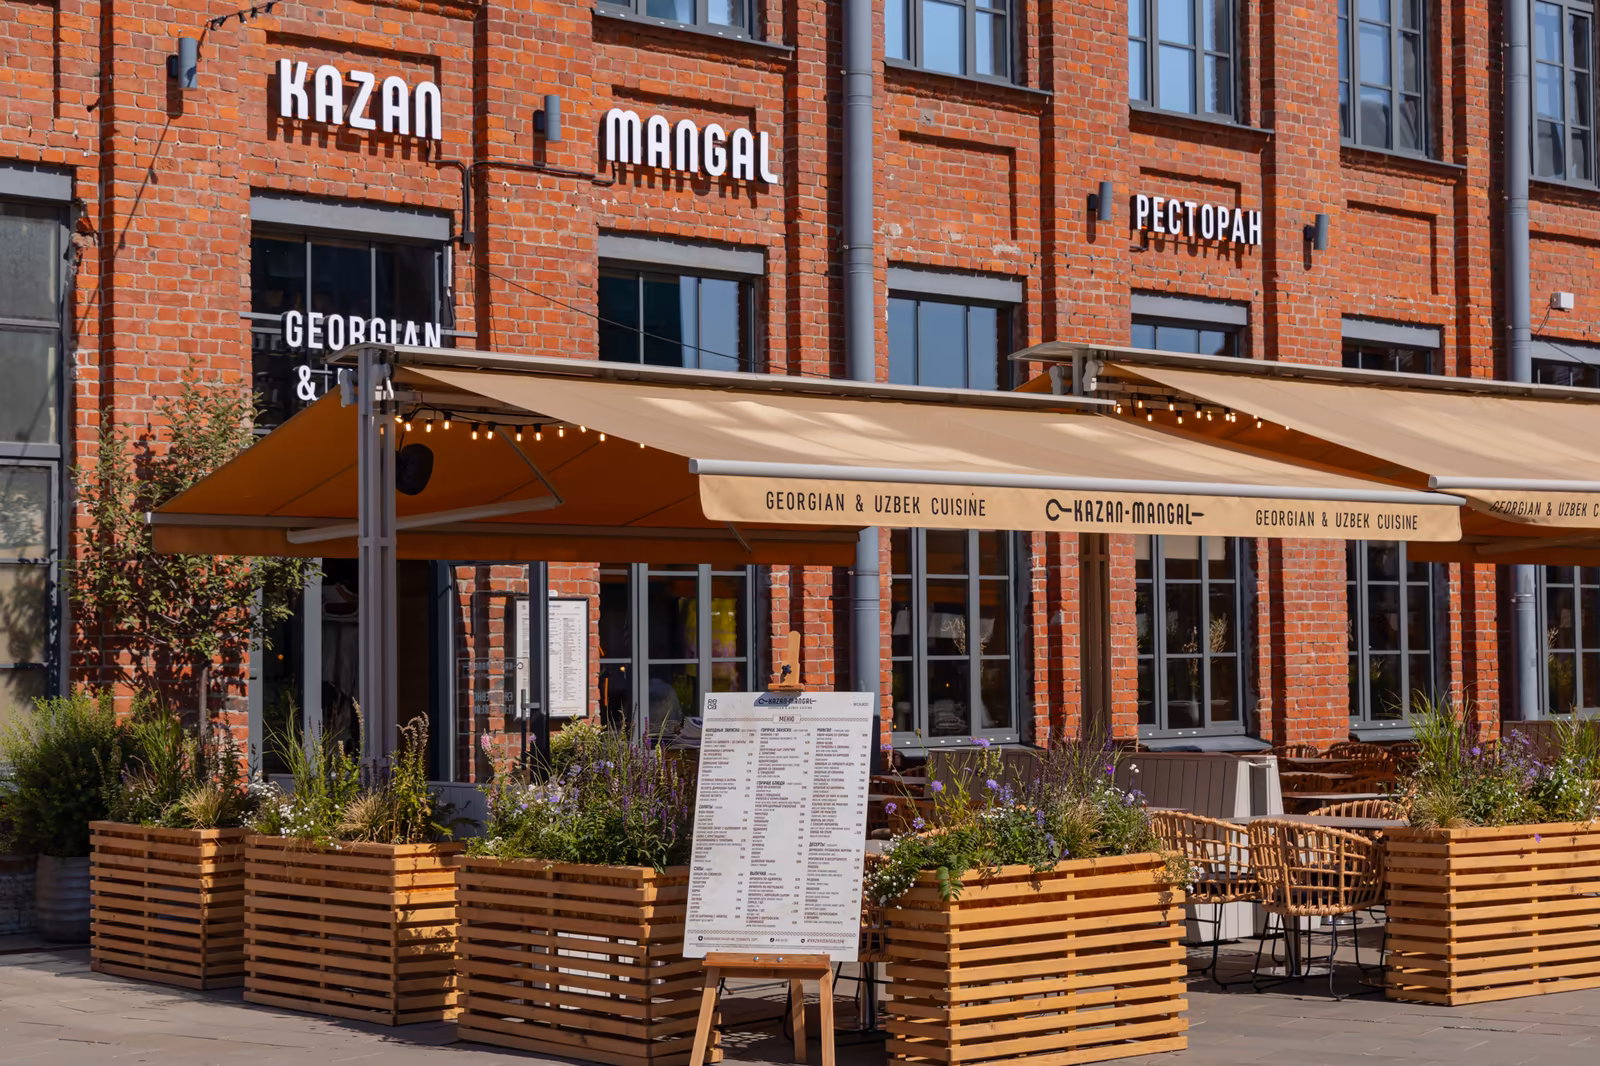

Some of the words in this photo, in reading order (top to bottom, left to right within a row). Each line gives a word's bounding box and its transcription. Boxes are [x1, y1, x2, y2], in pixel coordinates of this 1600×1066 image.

[280, 58, 442, 140] KAZAN
[606, 108, 778, 184] MANGAL
[1136, 194, 1262, 246] РЕСТОРАН
[285, 310, 441, 351] GEORGIAN
[297, 365, 318, 401] &
[766, 491, 845, 512] GEORGIAN
[855, 494, 864, 512] &
[874, 495, 921, 514] UZBEK
[931, 497, 986, 517] CUISINE
[1256, 509, 1315, 527] GEORGIAN
[1321, 511, 1329, 527] &
[1335, 512, 1370, 528] UZBEK
[1377, 514, 1418, 530] CUISINE
[1489, 500, 1541, 516] GEORGIAN
[1546, 502, 1553, 516] &
[1558, 502, 1587, 517] UZBEK
